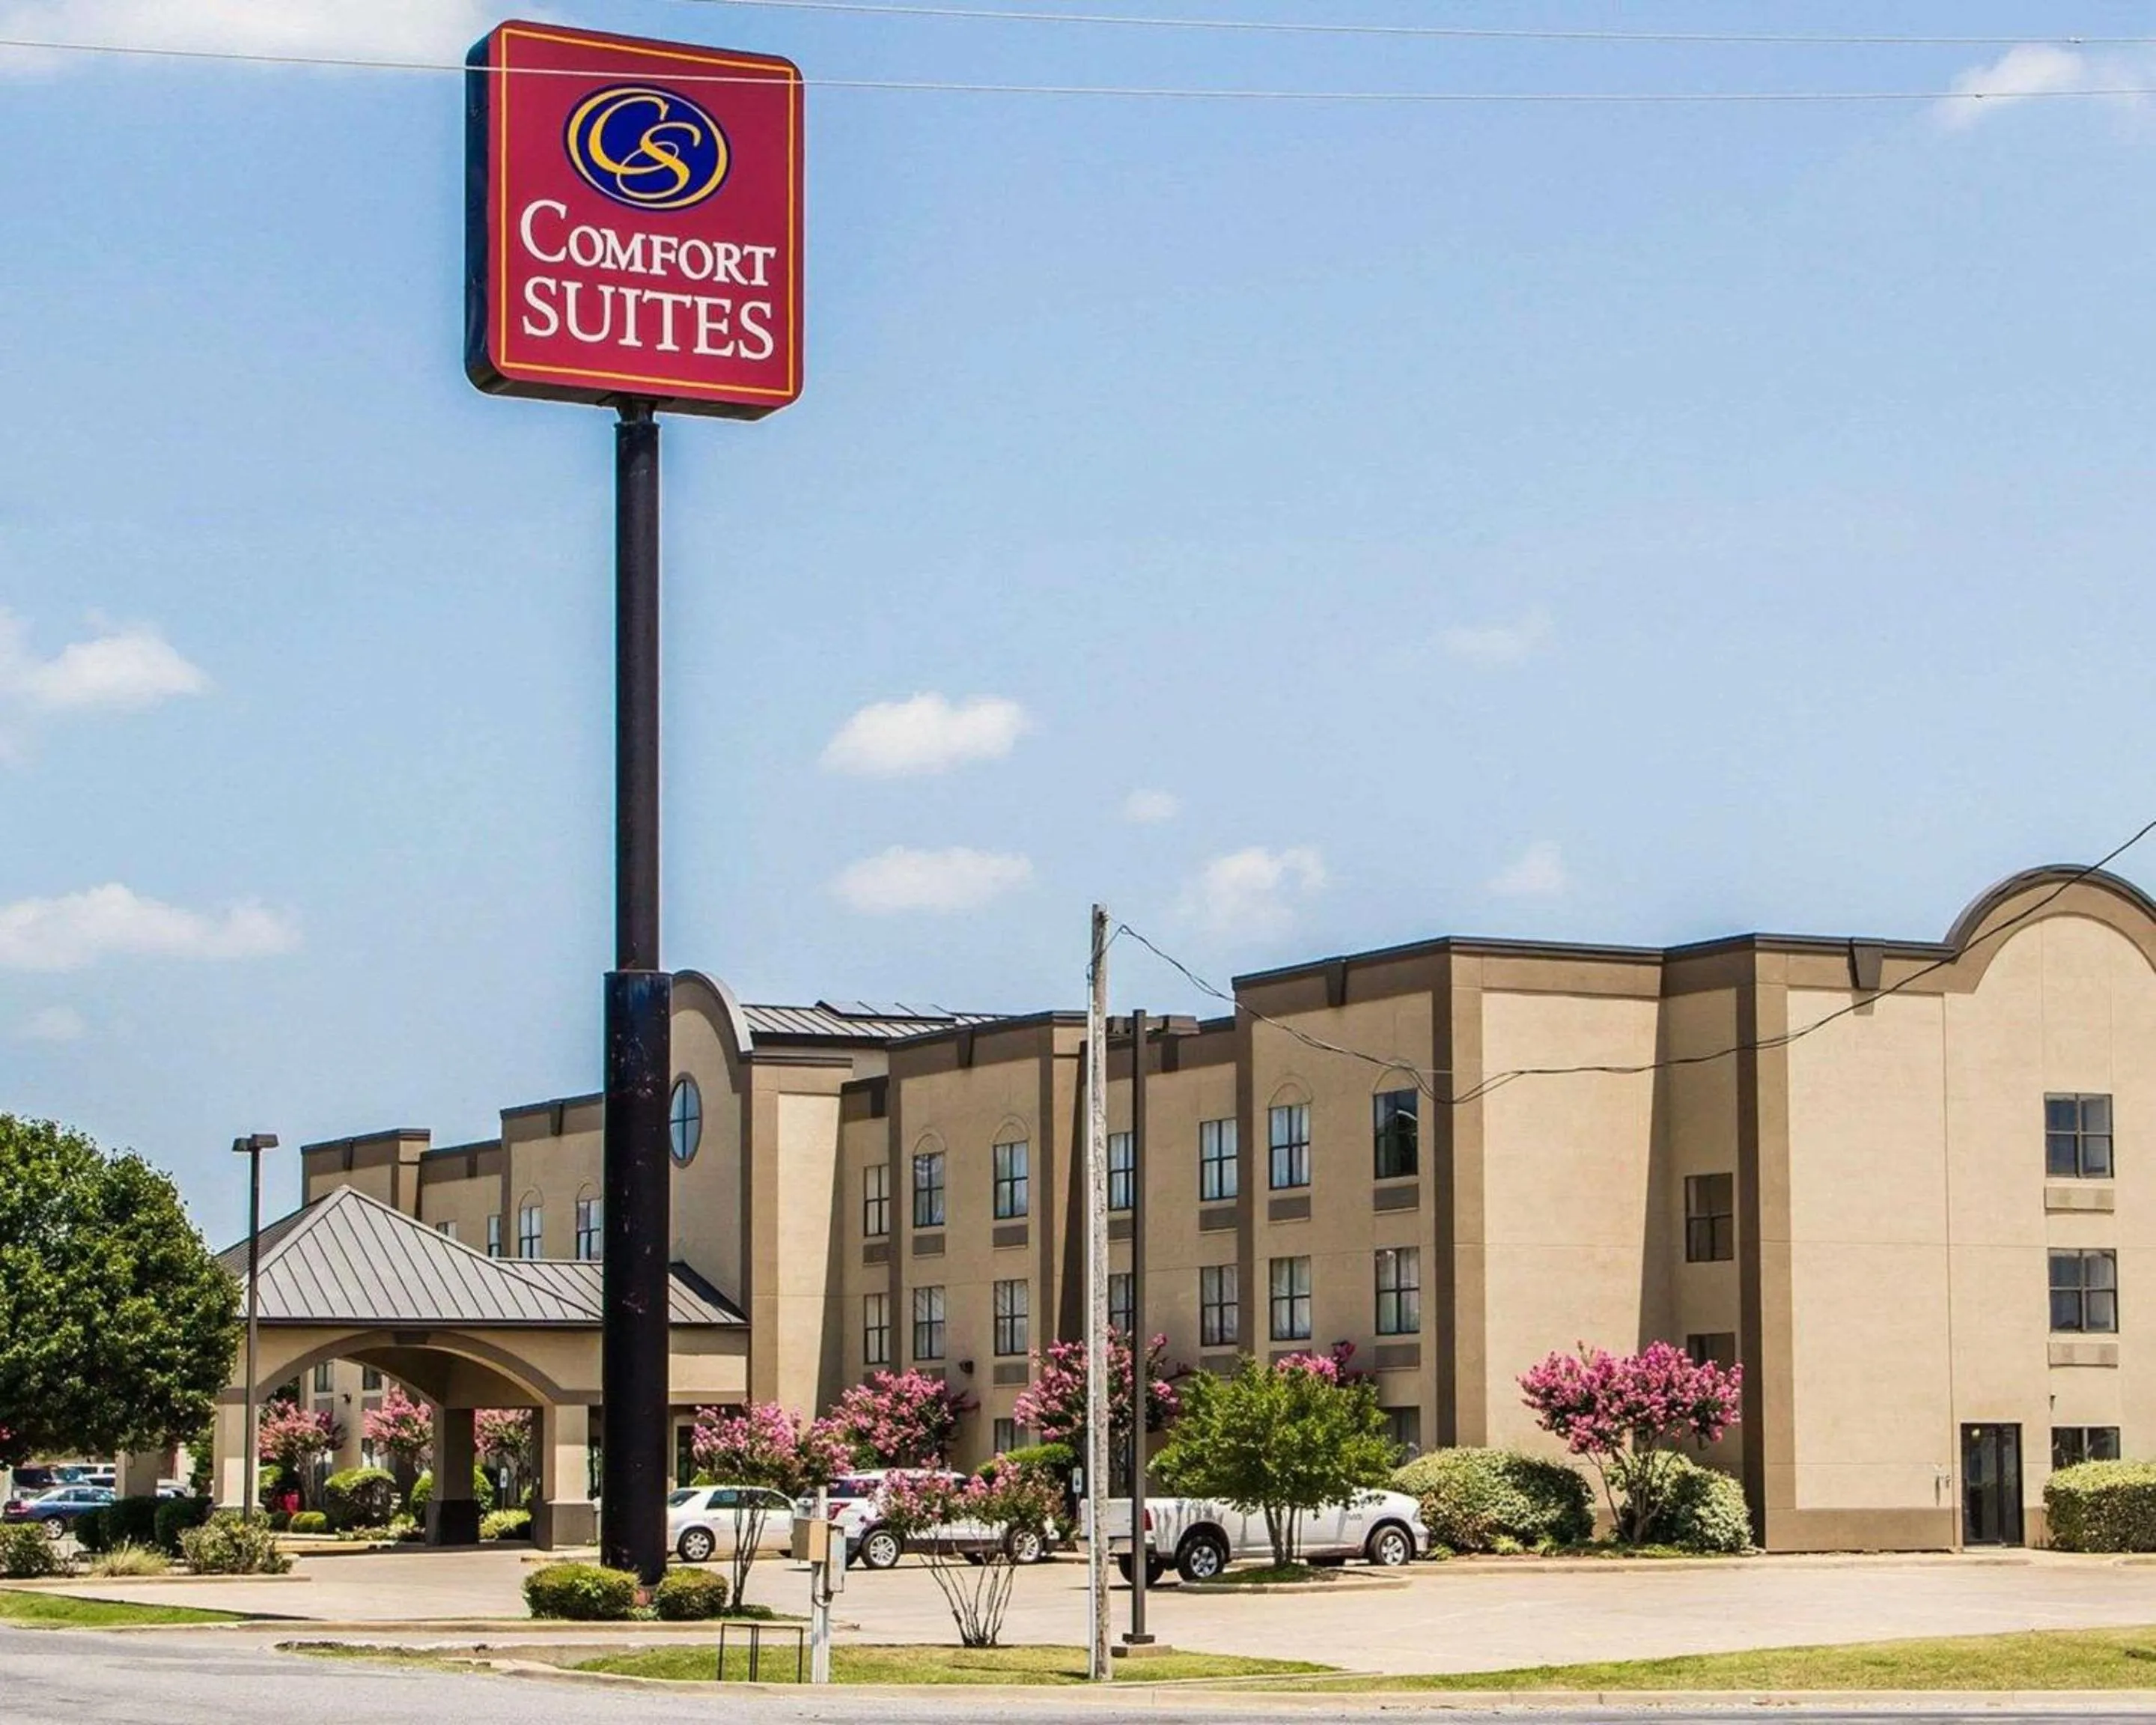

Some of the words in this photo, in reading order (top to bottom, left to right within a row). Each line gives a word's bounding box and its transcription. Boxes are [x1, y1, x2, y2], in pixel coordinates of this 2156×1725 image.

[588, 96, 701, 199] CS
[520, 199, 776, 286] COMFORT
[523, 276, 775, 359] SUITES
